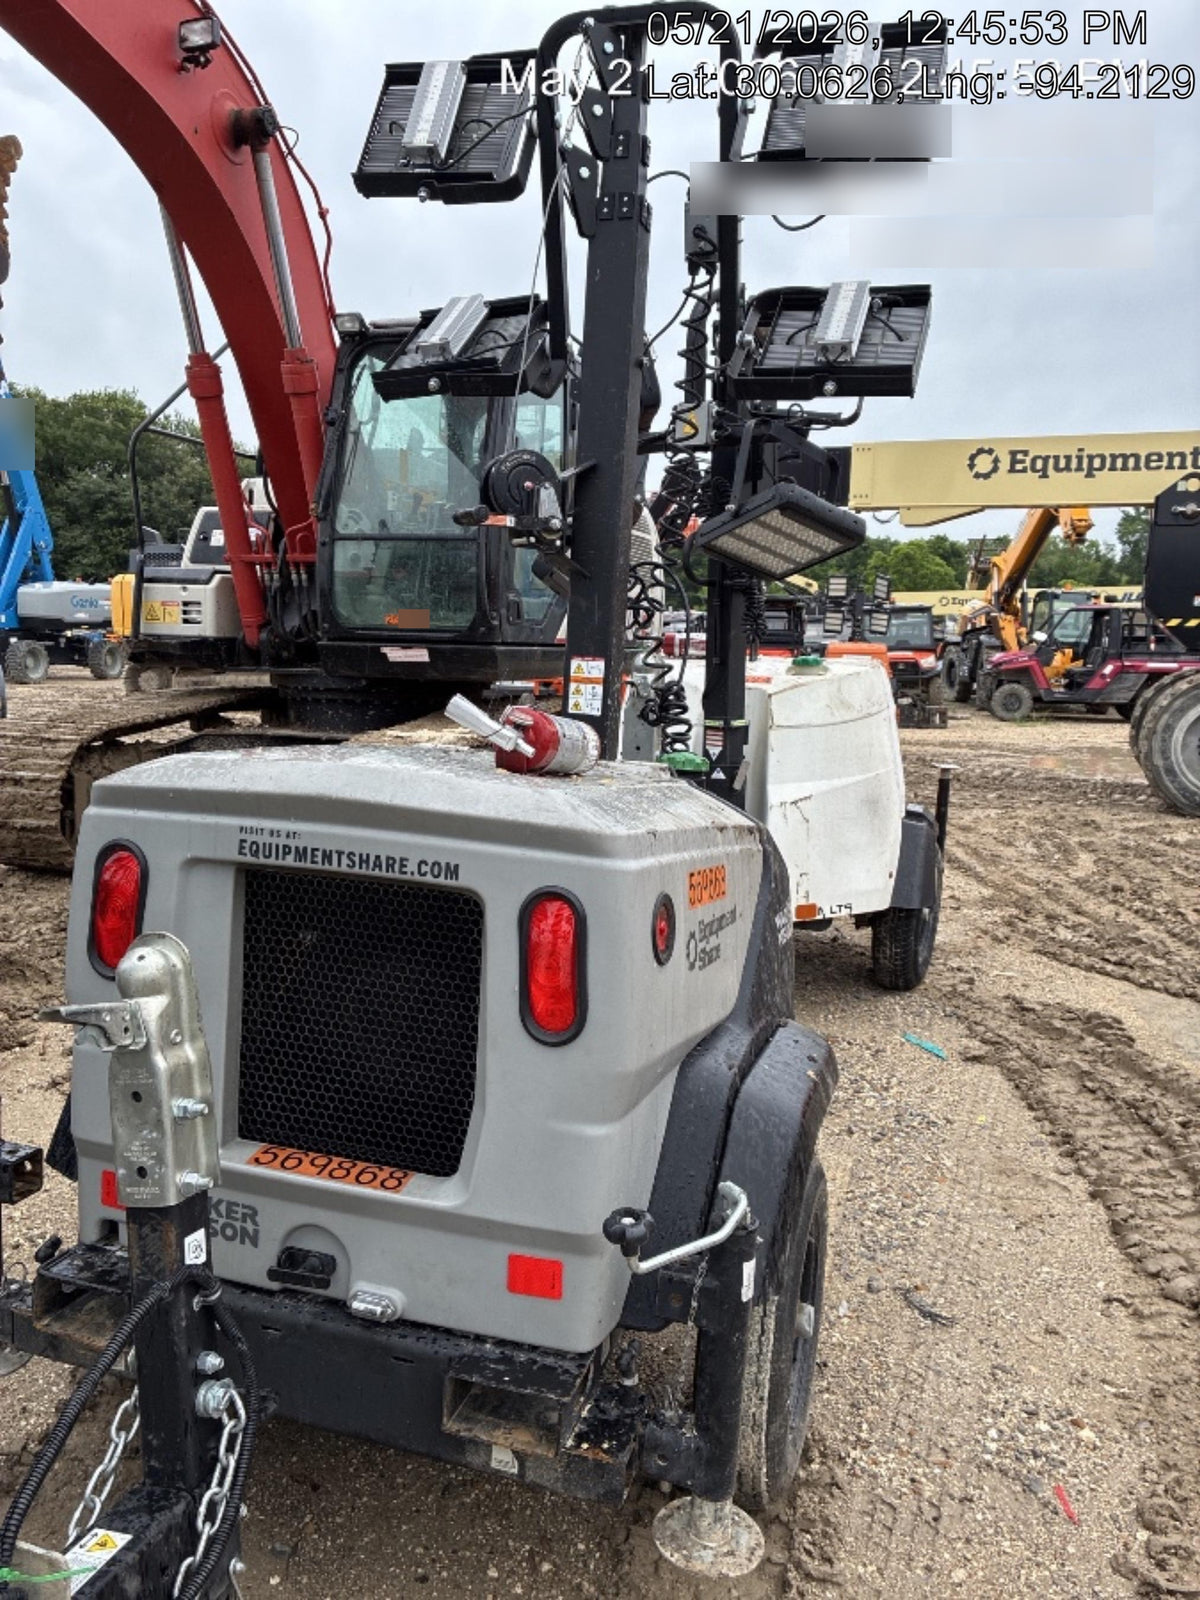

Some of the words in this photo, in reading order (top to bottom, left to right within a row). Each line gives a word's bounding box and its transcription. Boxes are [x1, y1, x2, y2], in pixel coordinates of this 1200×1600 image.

[1007, 446, 1200, 479] Equipment
[239, 825, 265, 836] VISIT
[238, 838, 460, 881] EQUIPMENTSHARE.COM
[253, 1145, 410, 1191] 569868
